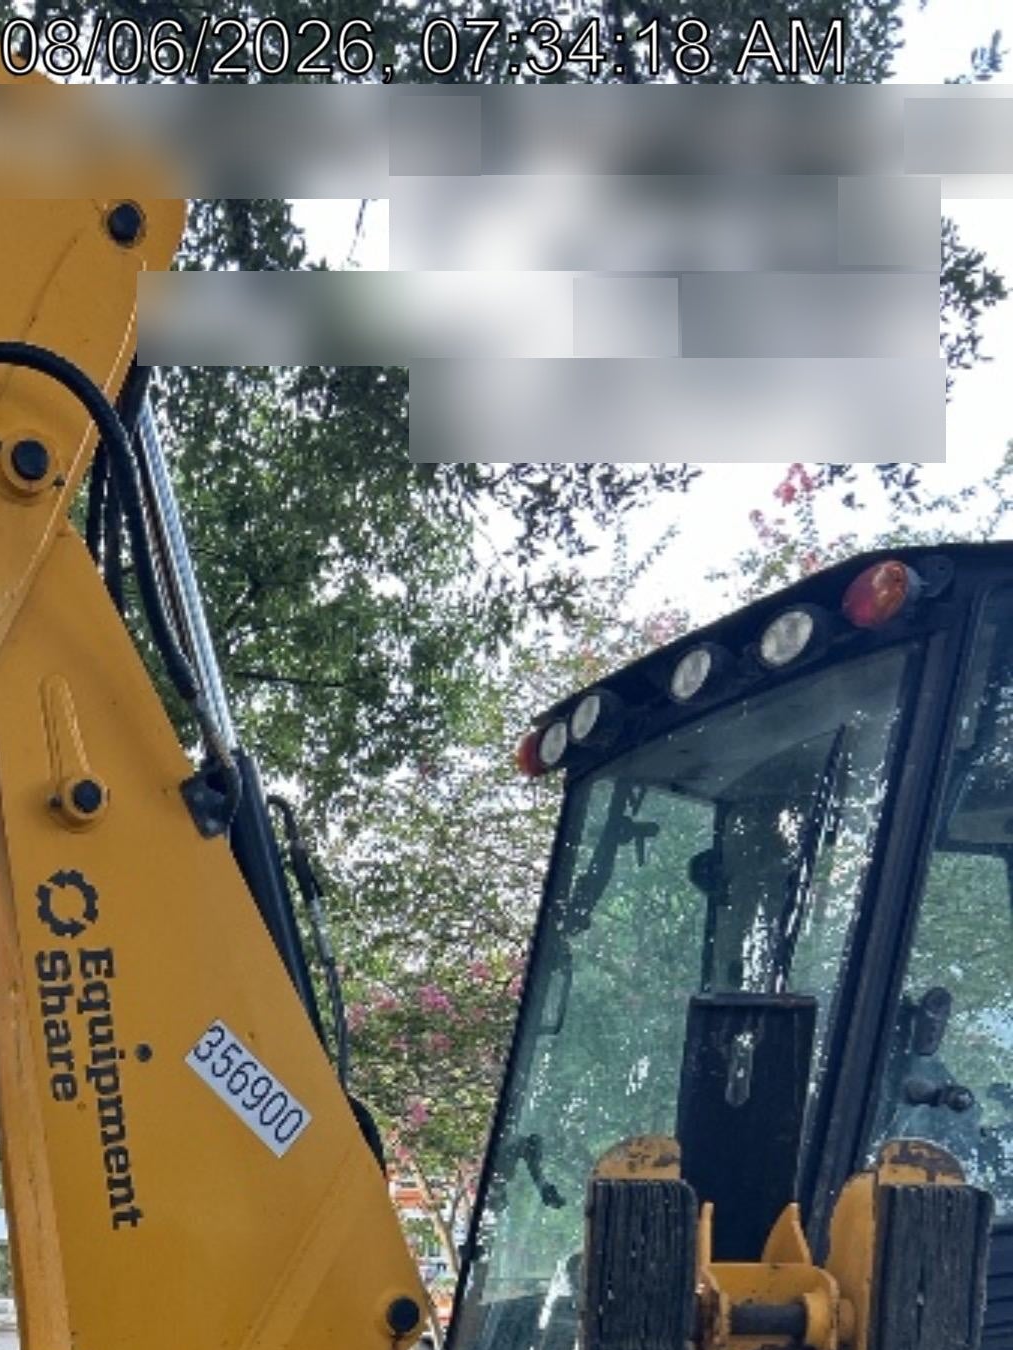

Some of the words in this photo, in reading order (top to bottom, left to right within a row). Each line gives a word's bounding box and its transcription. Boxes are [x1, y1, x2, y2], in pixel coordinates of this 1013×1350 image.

[35, 949, 79, 1102] Share
[77, 947, 144, 1231] Equipment
[193, 1024, 303, 1143] 356900
